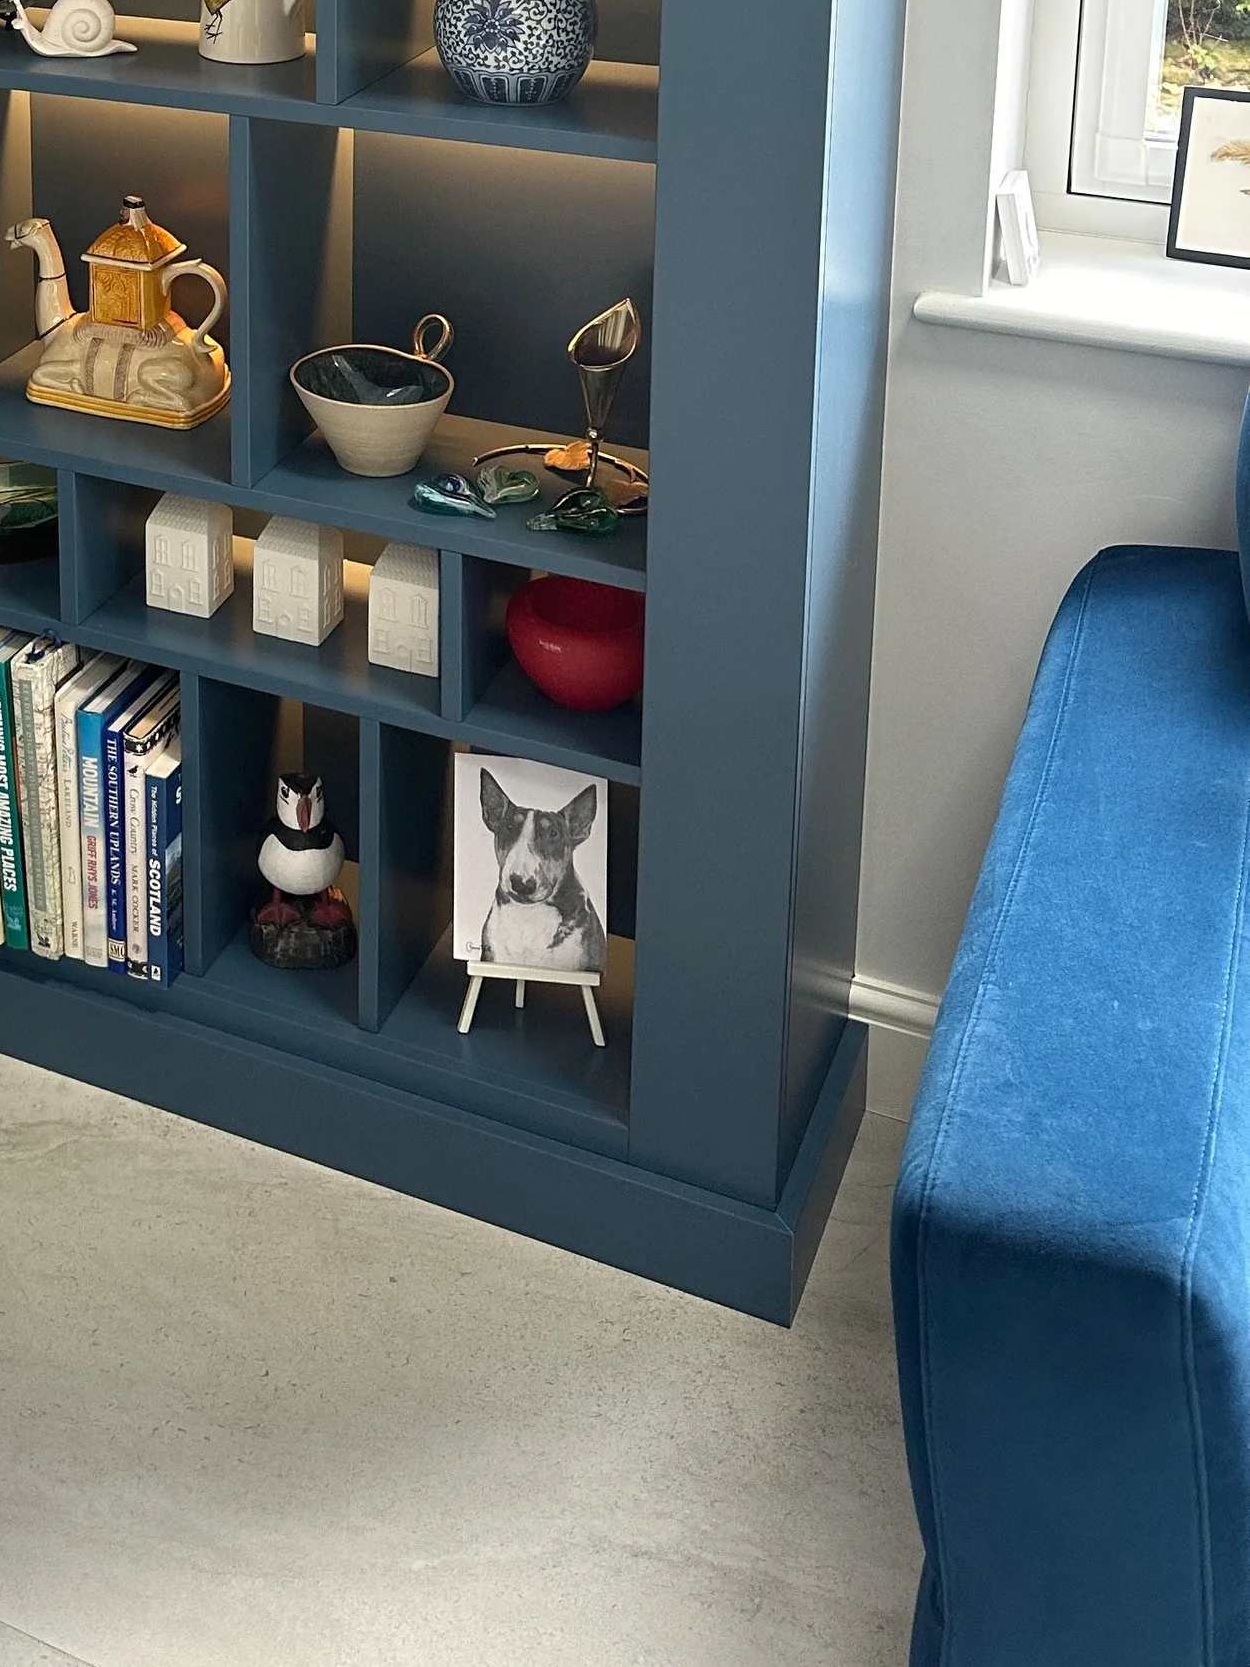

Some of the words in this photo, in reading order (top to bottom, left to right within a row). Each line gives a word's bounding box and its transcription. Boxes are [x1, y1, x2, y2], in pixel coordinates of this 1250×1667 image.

[106, 738, 118, 763] THE
[82, 755, 100, 829] MOUNTAIN
[108, 765, 120, 830] SOUTHERN
[130, 788, 139, 815] Crow
[86, 835, 97, 861] GRIFF
[129, 817, 140, 858] Country
[1, 846, 17, 892] PLACES
[87, 861, 98, 882] RHYS
[110, 831, 121, 885] UPLANDS
[87, 882, 99, 910] JONES
[131, 865, 139, 891] MARK
[132, 895, 140, 932] COCKER
[149, 858, 162, 936] SCOTLAND
